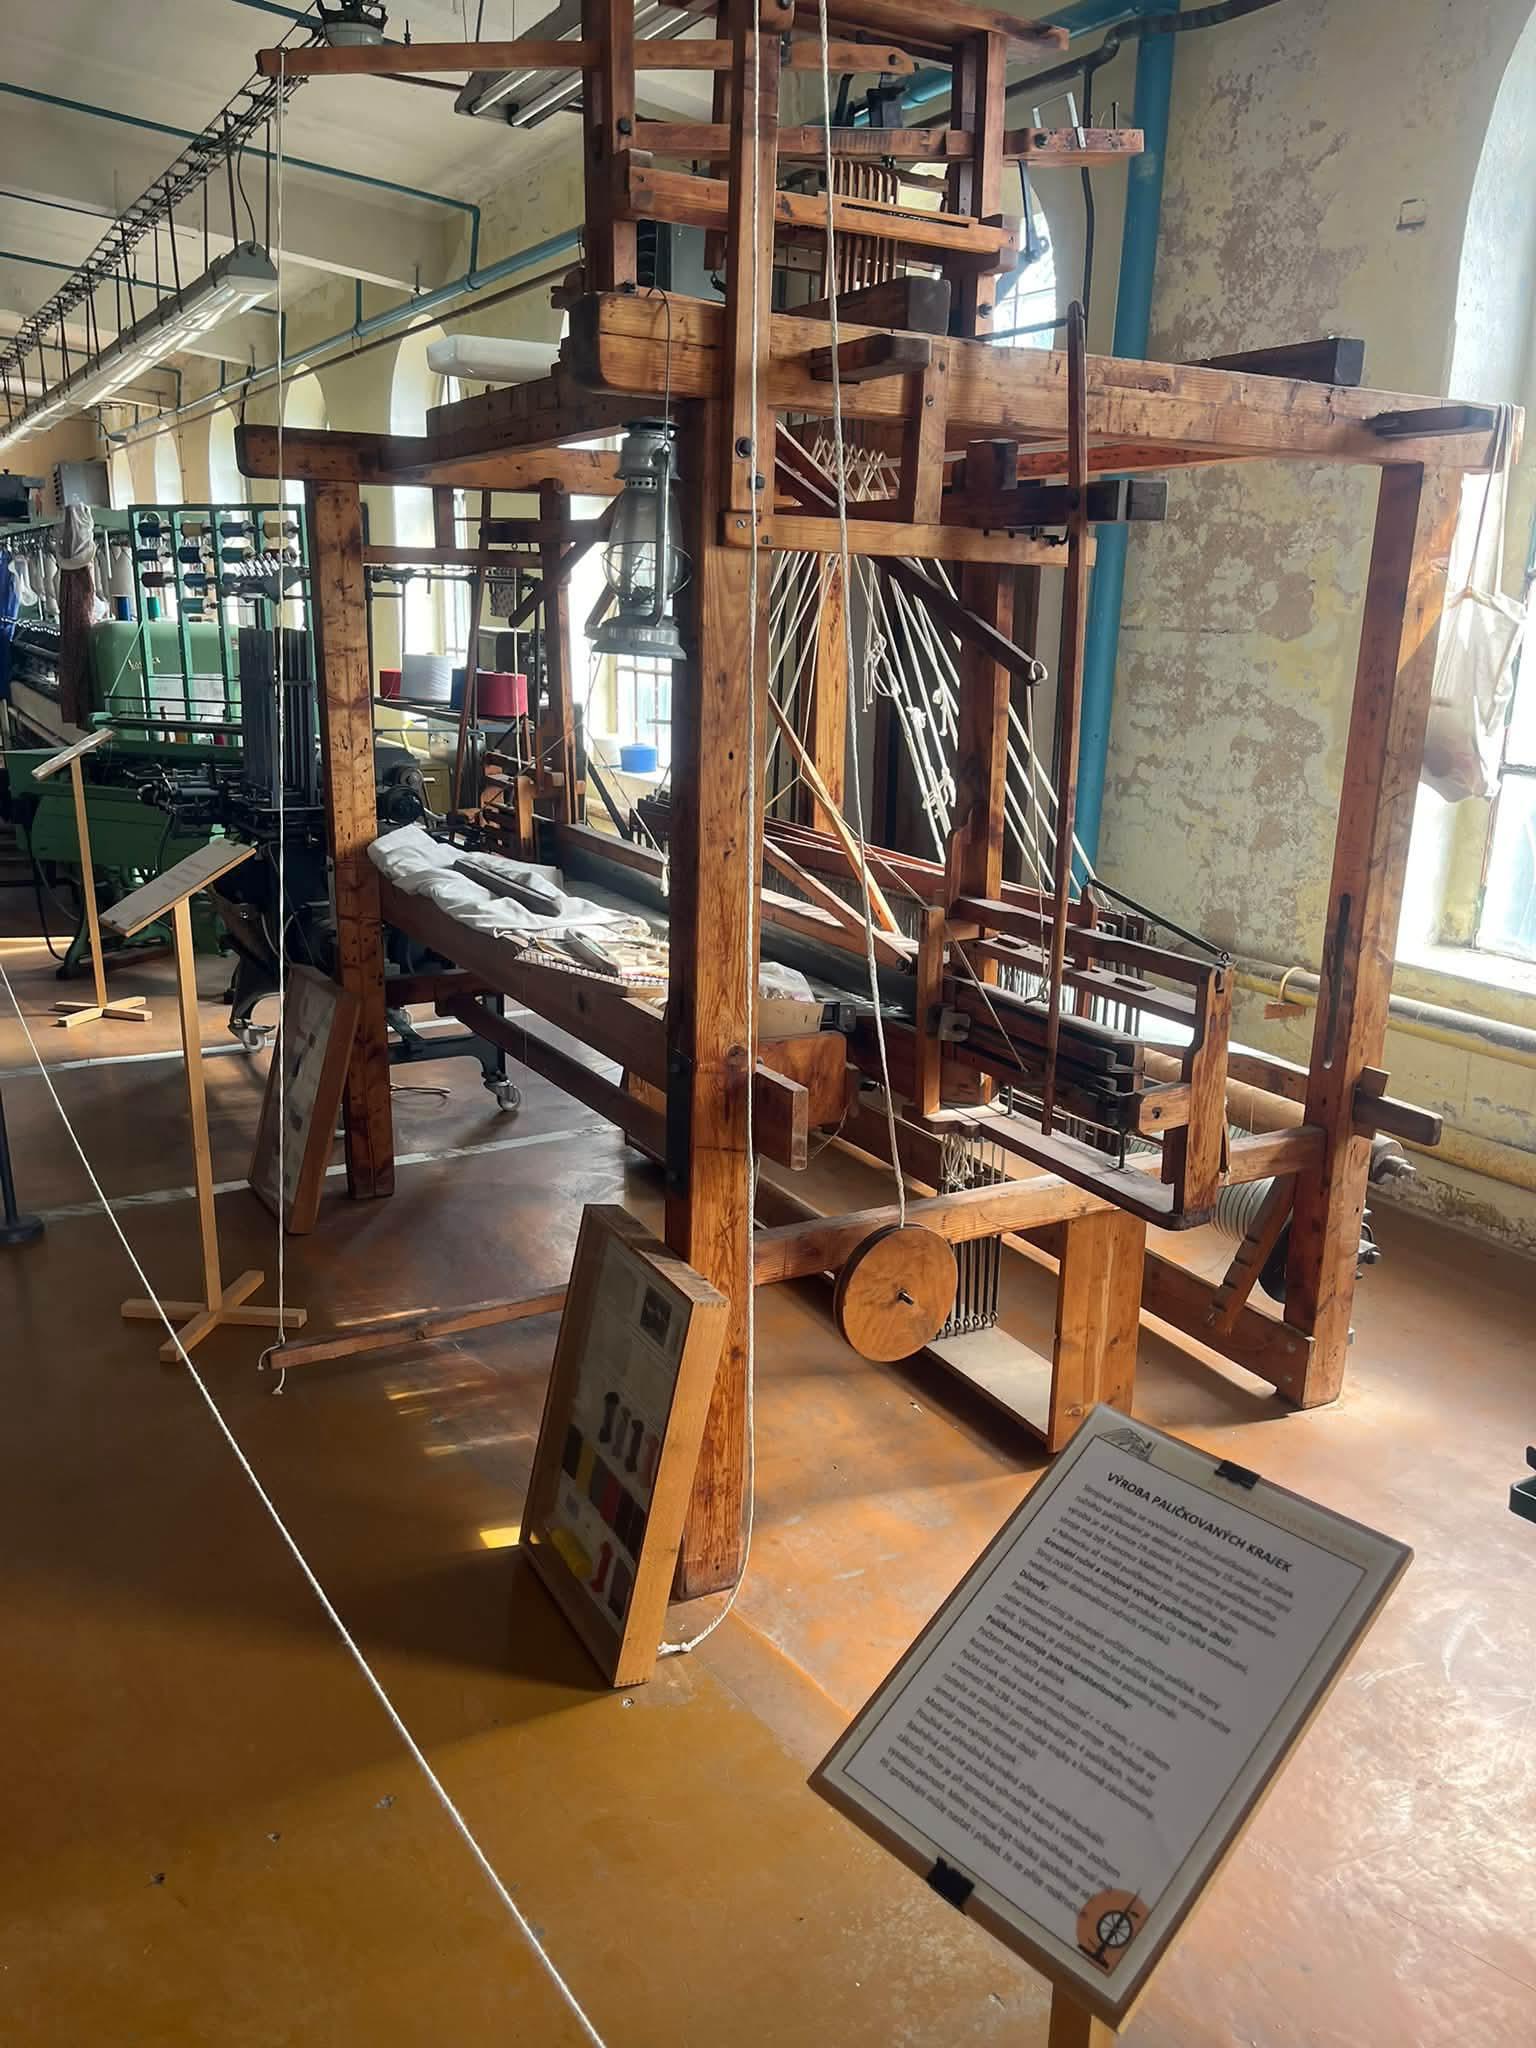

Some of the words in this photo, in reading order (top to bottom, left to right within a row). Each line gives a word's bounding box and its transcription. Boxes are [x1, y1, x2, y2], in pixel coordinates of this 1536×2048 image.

[1105, 1470, 1154, 1500] VÝROBA
[1150, 1493, 1248, 1549] PALIČKOVANÝCH
[1245, 1542, 1293, 1572] KRAJEK
